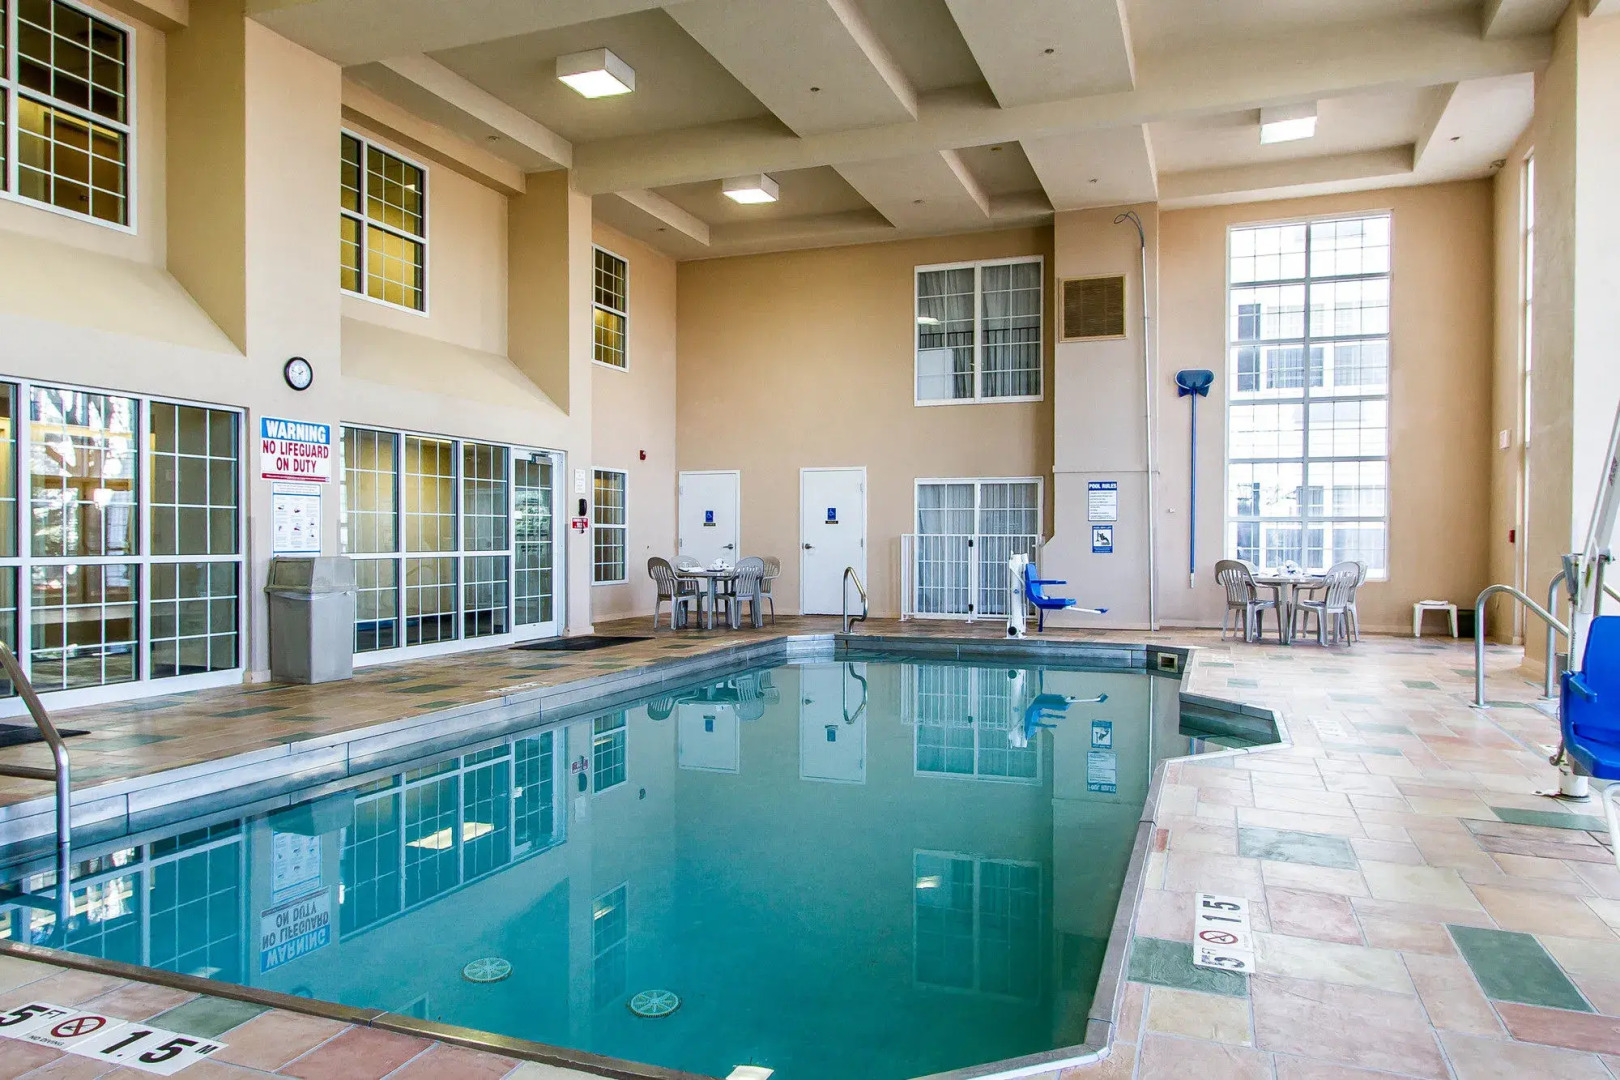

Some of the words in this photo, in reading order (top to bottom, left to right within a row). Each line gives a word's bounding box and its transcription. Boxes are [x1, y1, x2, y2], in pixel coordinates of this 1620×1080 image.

[265, 419, 327, 444] WARNING
[262, 440, 276, 455] NO
[280, 441, 329, 459] LIFEGUARD
[276, 457, 289, 471] ON
[293, 459, 317, 474] DUTY
[1201, 954, 1246, 969] 5
[39, 1009, 68, 1019] FT
[29, 1034, 42, 1042] NO
[40, 1036, 66, 1047] DIVING
[195, 1044, 220, 1055] M
